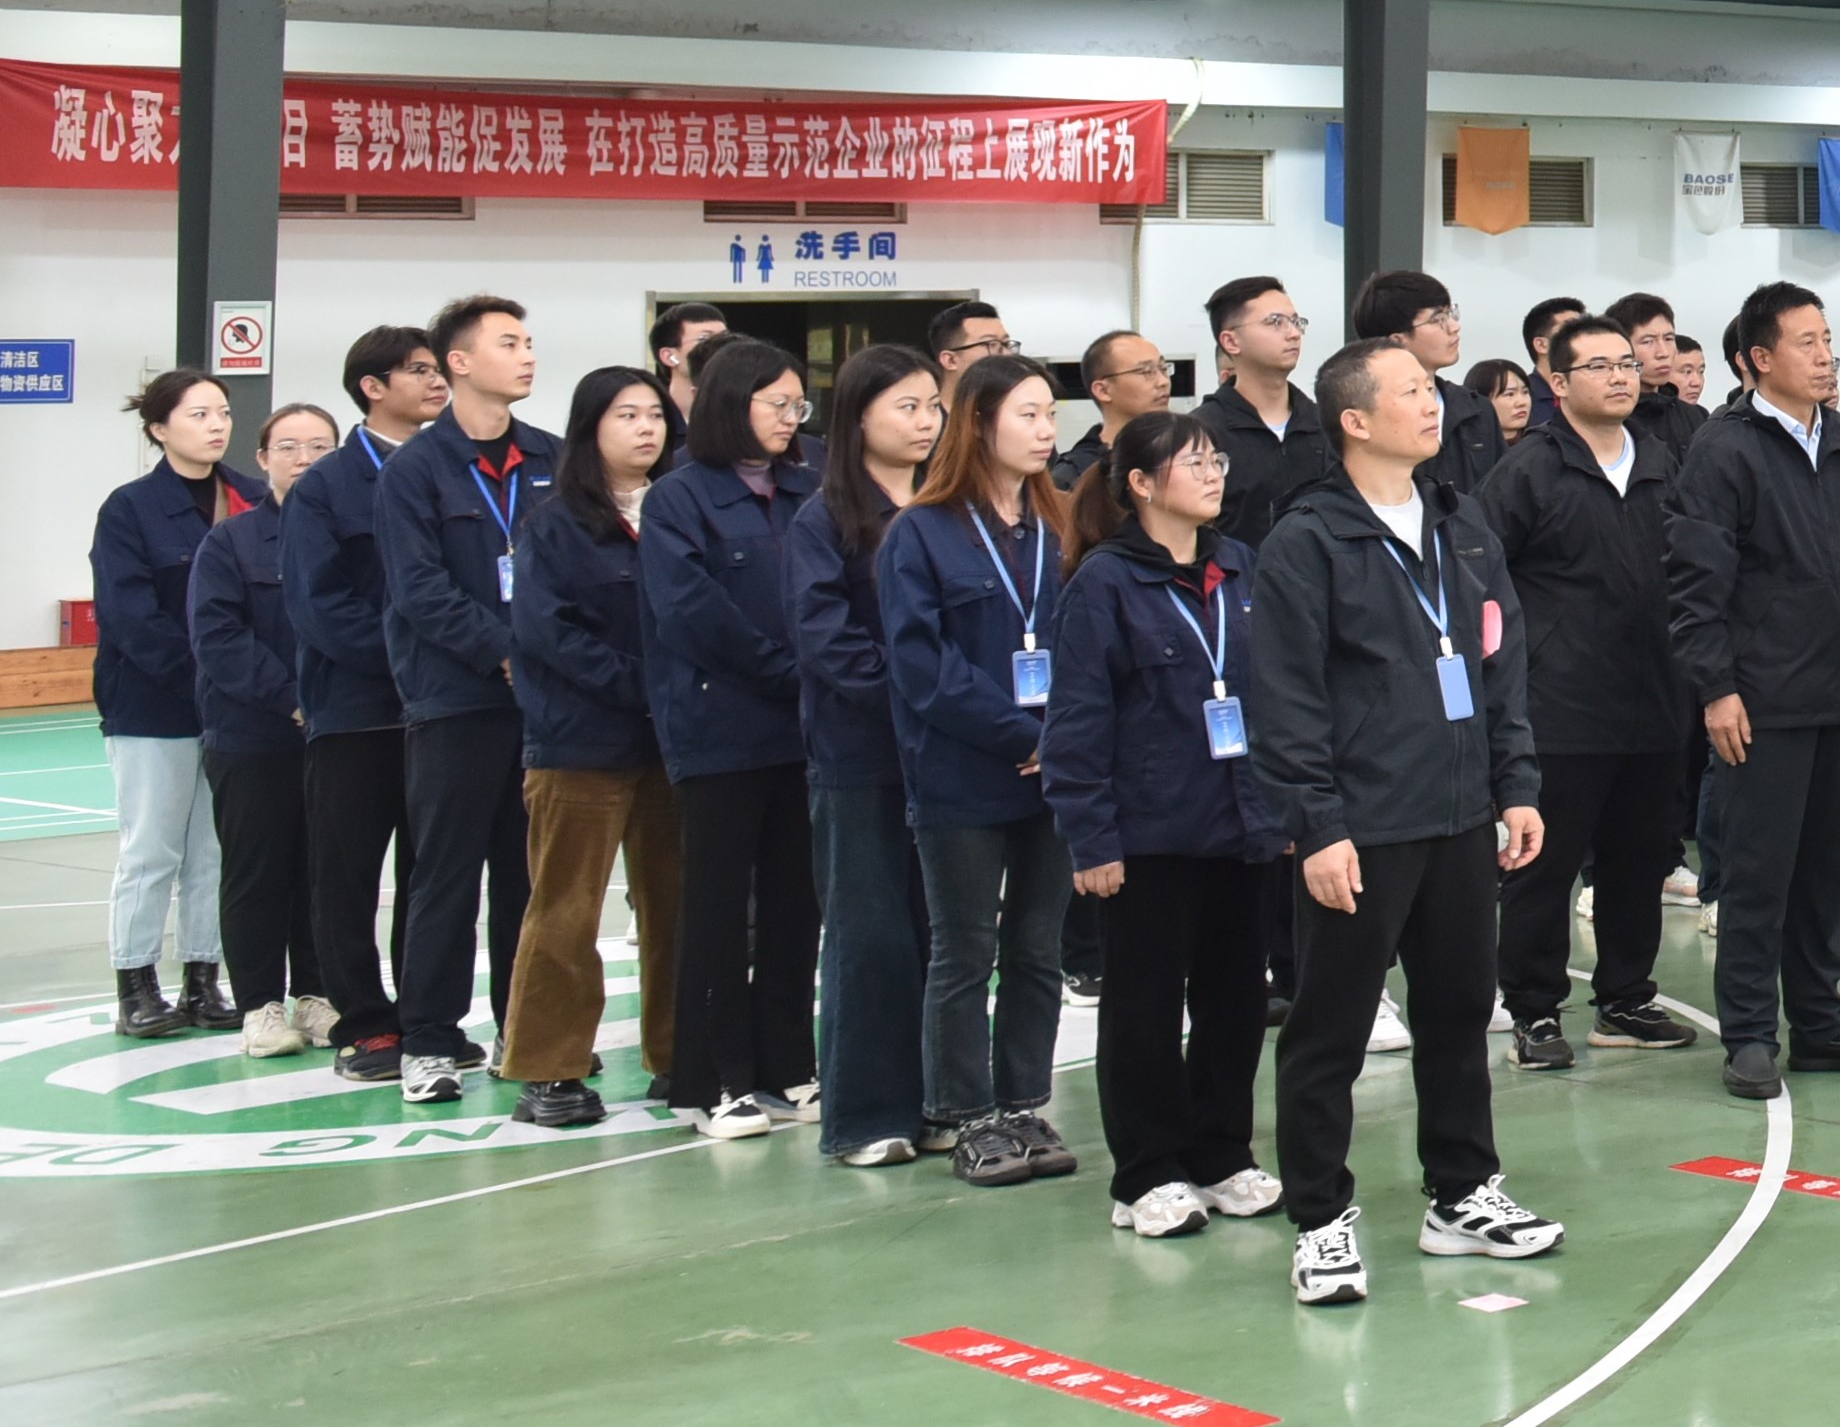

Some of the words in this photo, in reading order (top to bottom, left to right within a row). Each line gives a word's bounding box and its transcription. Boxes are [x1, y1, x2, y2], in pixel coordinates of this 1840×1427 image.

[331, 98, 567, 175] 蓄势赋能促发展
[585, 108, 1136, 184] 在打造高质量示范企业的征程上展现新作为
[795, 231, 897, 260] 洗手间
[794, 271, 897, 288] RESTROOM
